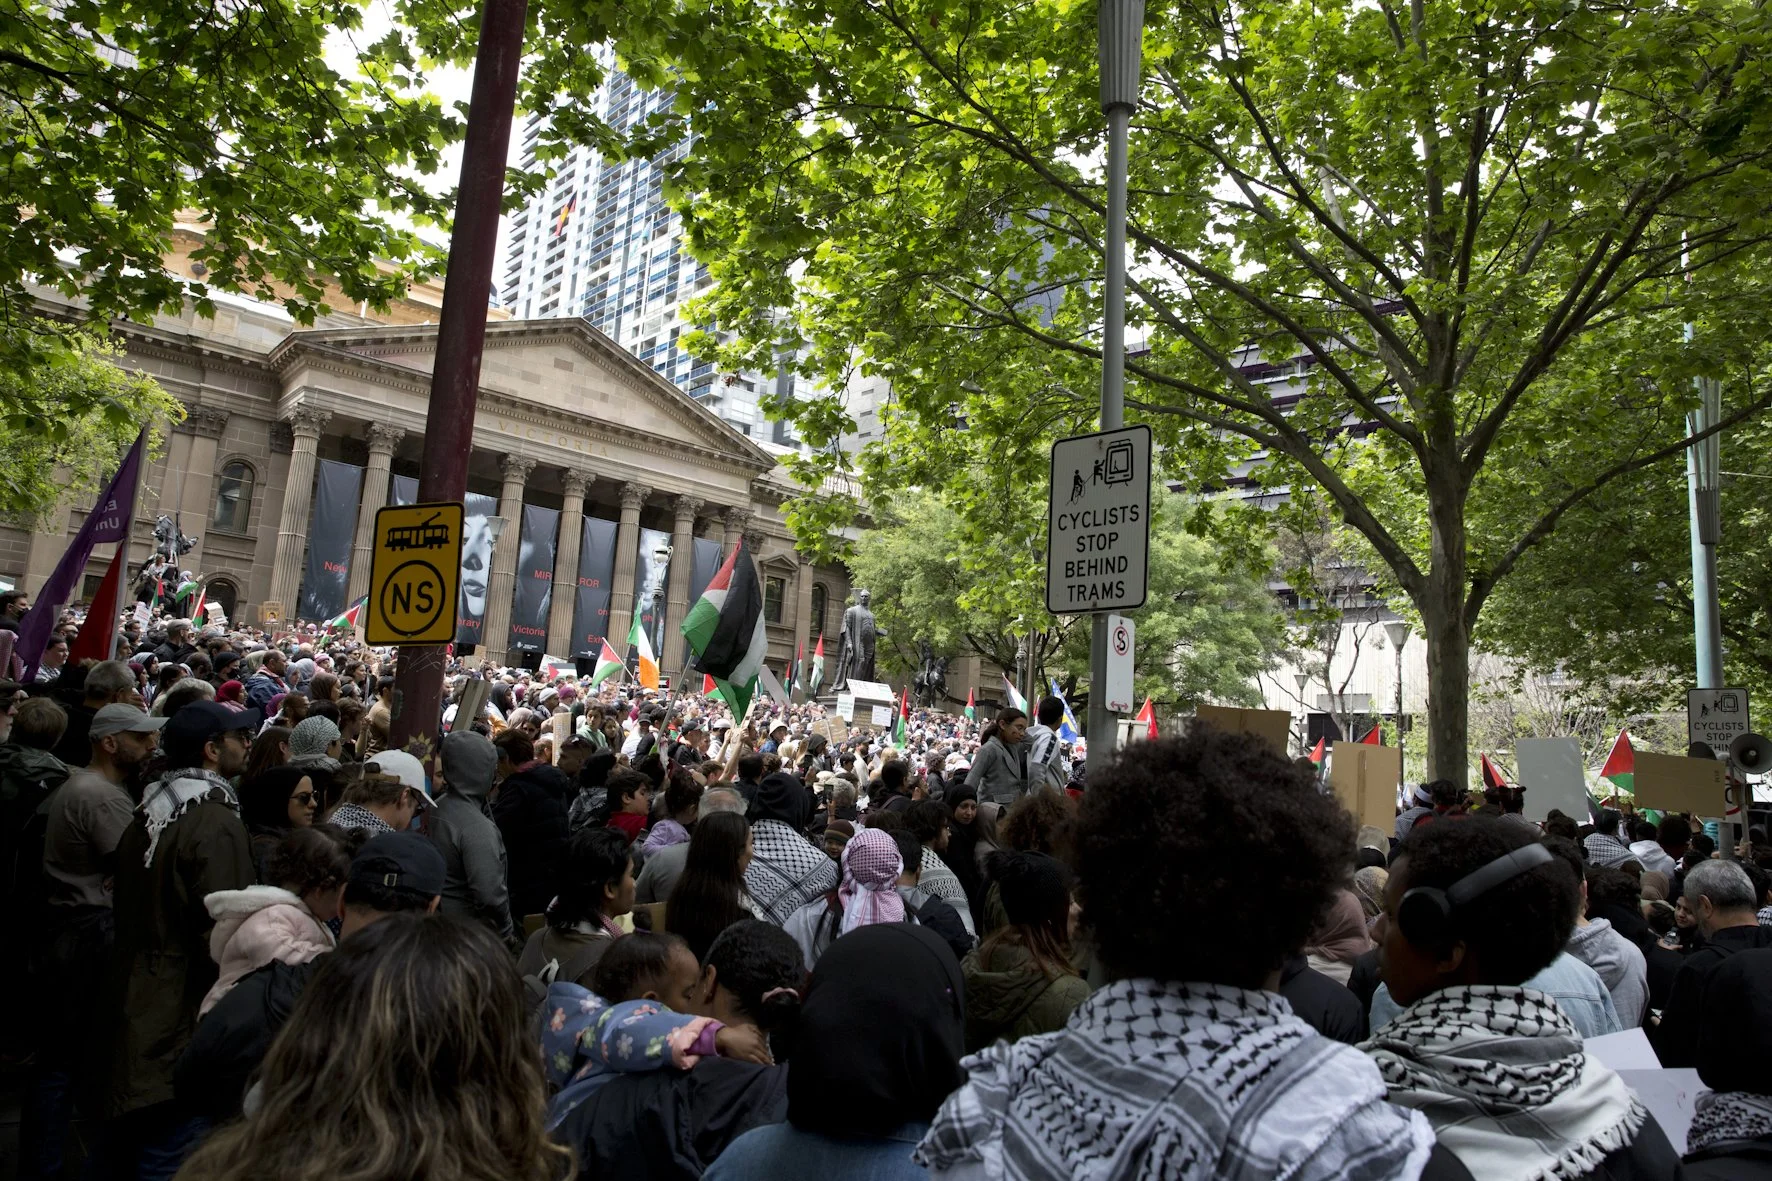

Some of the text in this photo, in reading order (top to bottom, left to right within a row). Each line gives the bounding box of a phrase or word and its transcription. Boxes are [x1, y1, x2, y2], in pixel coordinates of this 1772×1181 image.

[498, 420, 609, 457] VICTORIA
[1058, 504, 1140, 531] CYCLISTS
[1076, 531, 1119, 553] STOP
[324, 560, 347, 573] New
[534, 569, 553, 580] MIR
[1065, 555, 1129, 578] BEHIND
[579, 577, 600, 588] ROR
[391, 581, 434, 614] NS
[1067, 580, 1126, 603] TRAMS
[512, 624, 546, 637] Victoria
[1693, 721, 1745, 731] CYCLISTS
[1706, 732, 1733, 741] STOP
